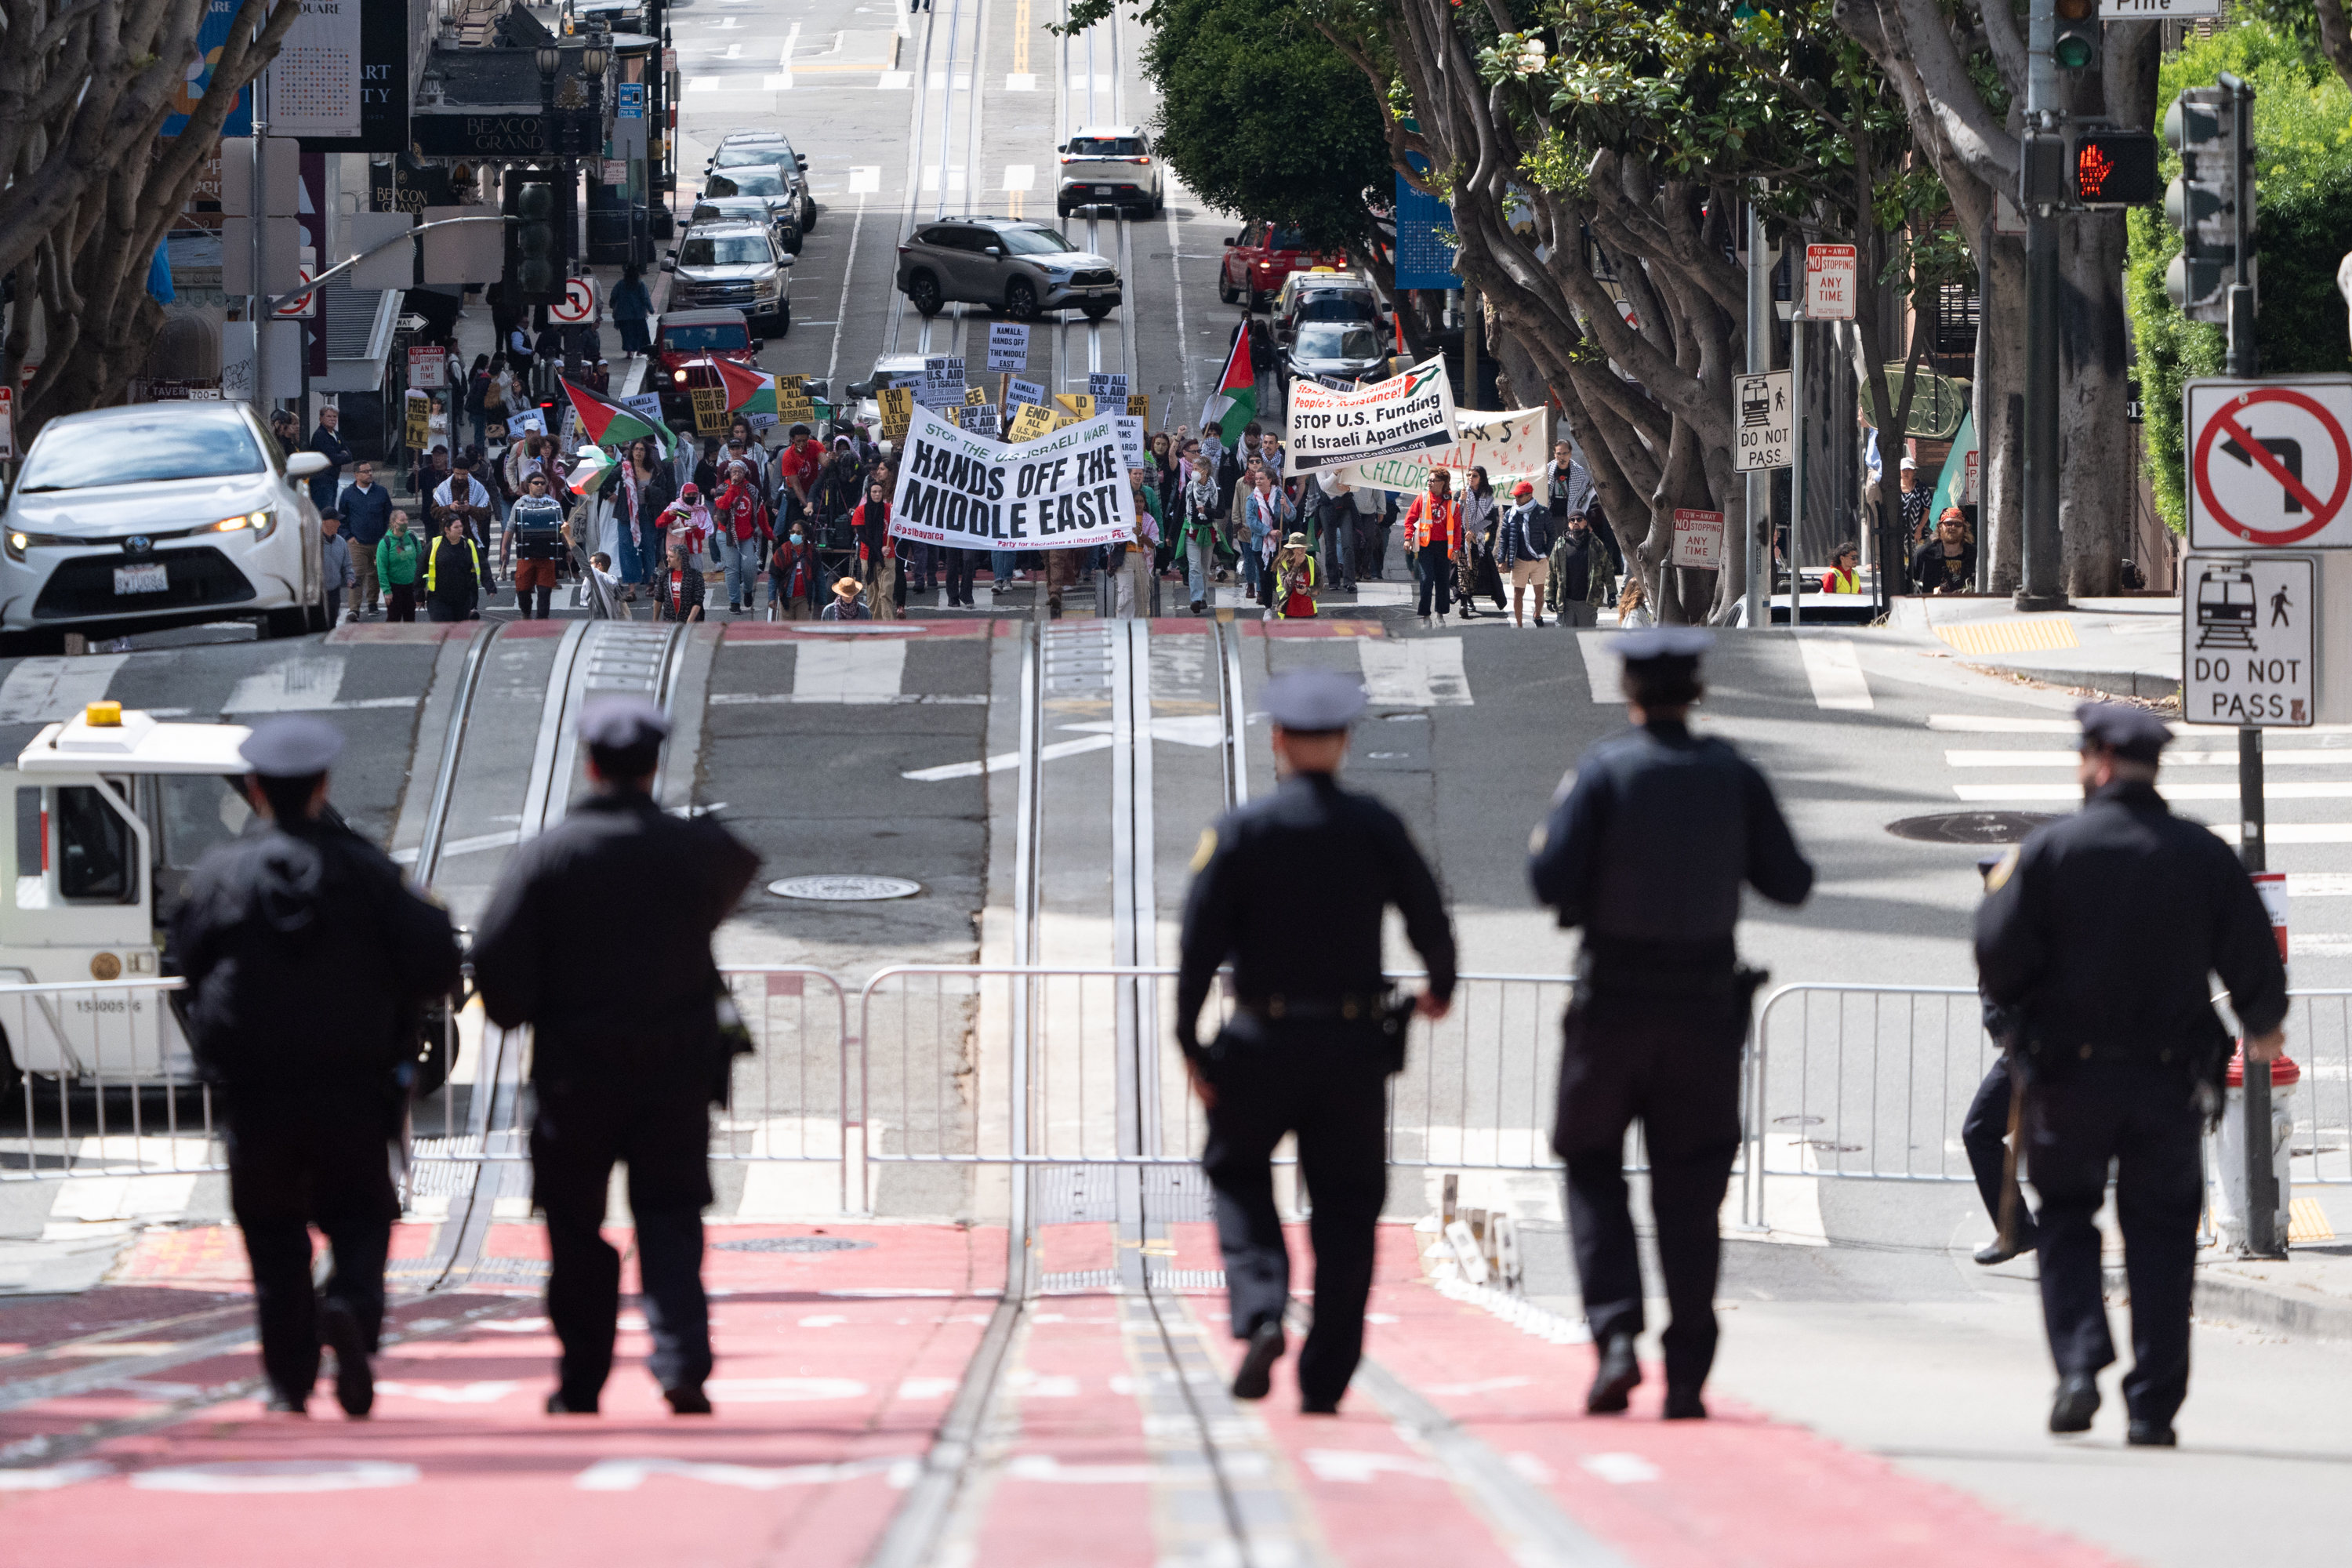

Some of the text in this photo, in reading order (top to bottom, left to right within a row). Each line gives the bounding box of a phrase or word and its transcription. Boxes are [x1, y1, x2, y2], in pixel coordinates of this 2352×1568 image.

[298, 3, 341, 15] QUARE
[476, 136, 544, 150] GRAND
[377, 187, 427, 205] BEACON
[1813, 247, 1849, 256] TOW-AWAY
[1809, 256, 1853, 270] NO STOPPING
[1820, 277, 1842, 288] ANY
[1819, 290, 1842, 302] TIME
[996, 326, 1022, 336] KAMALA:
[992, 337, 1012, 346] HANDS
[410, 354, 419, 364] NO
[927, 358, 964, 370] END ALL
[926, 369, 964, 382] U.S. AID
[1091, 375, 1127, 386] END ALL
[781, 376, 803, 390] END
[895, 379, 921, 389] KAMALA:
[927, 379, 964, 390] TO ISRAEL
[1014, 382, 1037, 395] KAMALA:
[1320, 378, 1354, 392] END ALL
[694, 388, 726, 400] STOP US
[786, 390, 800, 399] ALL
[885, 389, 903, 403] END
[1089, 385, 1127, 397] U.S. AID
[1297, 384, 1326, 396] Stand
[628, 396, 653, 407] KAMALA:
[965, 390, 982, 404] EE
[1009, 392, 1038, 405] HANDS OFF
[1100, 396, 1126, 405] ISRAEL
[408, 398, 427, 414] FREE
[696, 399, 726, 411] ISRAEL
[782, 400, 808, 409] U.S. AID
[888, 402, 905, 415] ALL
[1007, 403, 1016, 412] THE
[1295, 397, 1334, 410] People's
[647, 405, 658, 415] OFF
[779, 408, 812, 419] TO ISRAEL!
[960, 407, 996, 419] END ALL
[1025, 405, 1050, 422] END
[1127, 406, 1146, 416] AELI
[1294, 394, 1441, 430] STOP U.S. Funding
[408, 413, 427, 423] PALESTINE
[514, 412, 538, 426] KAMALA:
[700, 413, 730, 429] WAR
[752, 416, 768, 426] EAST
[885, 413, 910, 425] U.S. AID
[960, 417, 996, 429] U.S. AID
[1026, 419, 1040, 429] ALL
[884, 423, 909, 435] TO ISRA
[970, 426, 996, 435] ISRAEL
[1016, 426, 1044, 437] U.S. AID
[1294, 410, 1444, 449] of Israeli Apartheid
[925, 423, 957, 443] STOP
[963, 440, 991, 459] THE
[1083, 424, 1109, 444] WAR!
[1010, 433, 1019, 441] TO
[1741, 428, 1788, 447] DO NOT
[1320, 441, 1427, 466] ANSWERCoalition.org
[1749, 448, 1780, 466] PASS
[910, 439, 1117, 501] HANDS OFF THE
[1360, 459, 1430, 491] CHILDR
[900, 478, 1121, 539] MIDDLE EAST!
[1682, 511, 1716, 521] TOW-AWAY
[1675, 519, 1721, 533] NO STOPPING
[894, 523, 944, 541] @pslbayarea
[997, 539, 1017, 549] Party
[1073, 534, 1108, 544] Liberation
[1112, 530, 1126, 539] PSL
[1686, 535, 1708, 546] ANY
[1685, 546, 1708, 556] TIME
[2196, 657, 2301, 684] DO NOT
[2212, 692, 2284, 718] PASS
[77, 1000, 142, 1013] 150056
